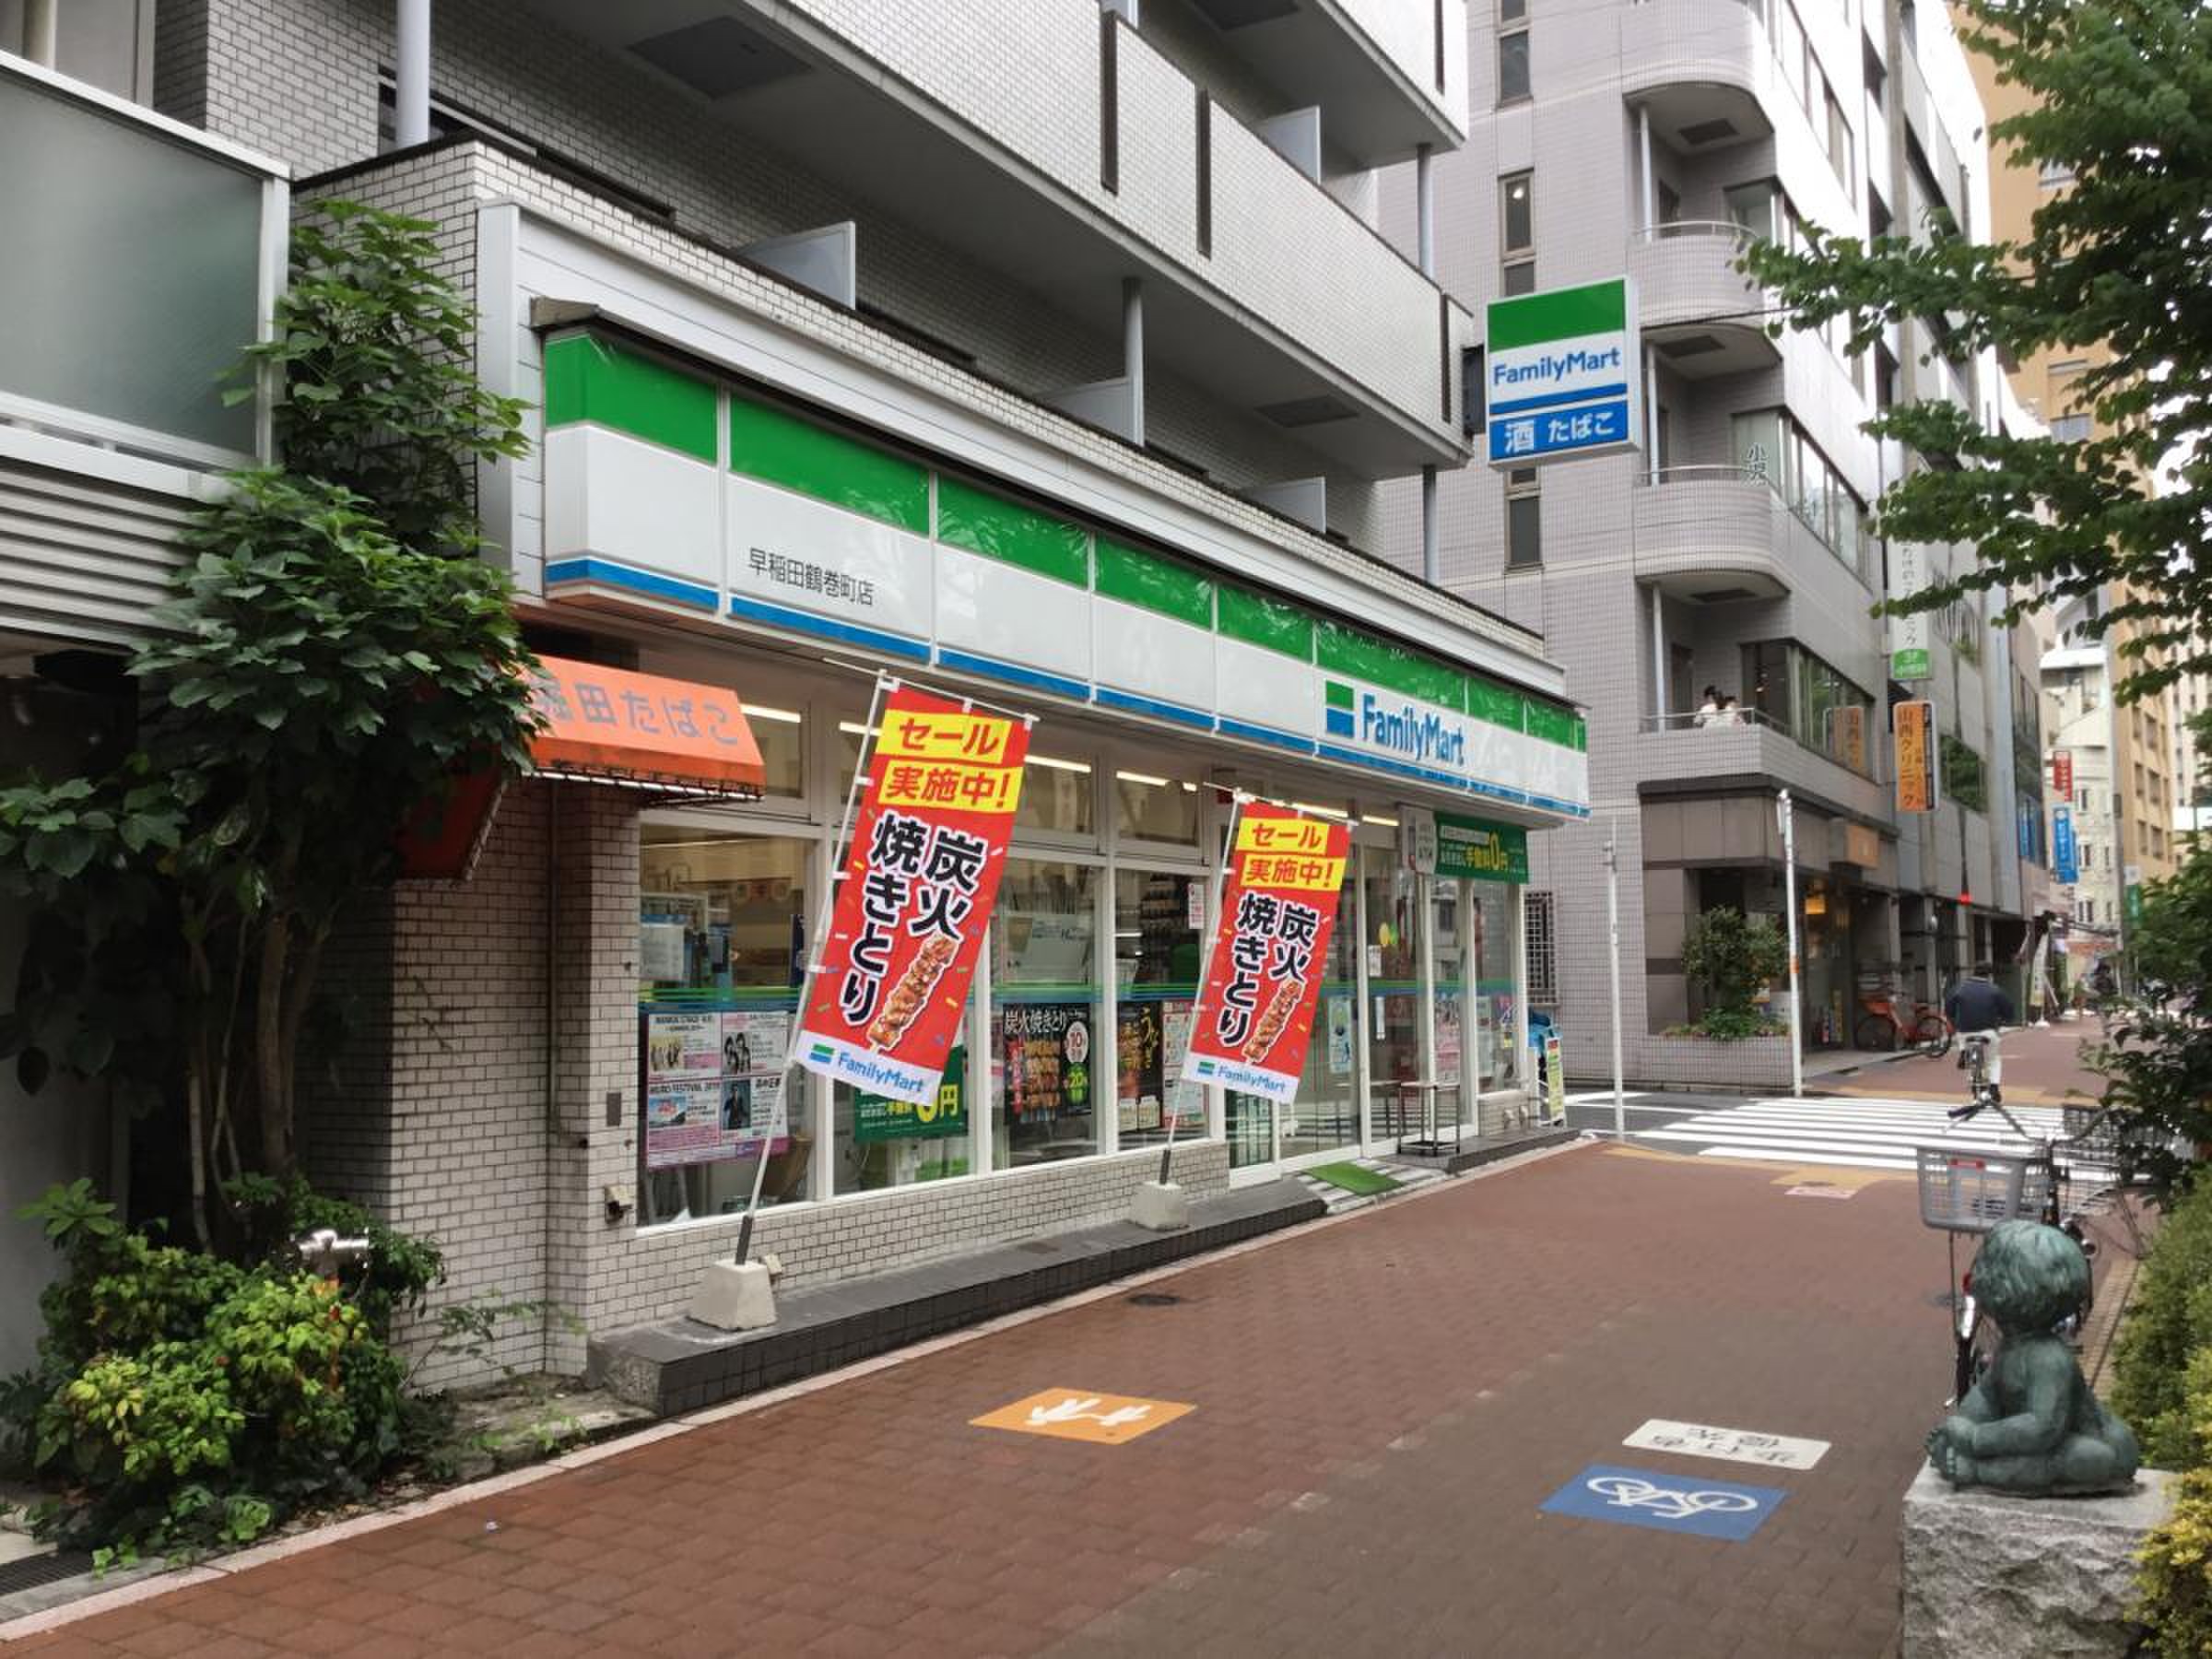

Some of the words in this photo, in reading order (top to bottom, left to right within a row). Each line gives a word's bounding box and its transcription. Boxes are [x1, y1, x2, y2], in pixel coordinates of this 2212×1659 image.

[1493, 347, 1621, 386] FamilyMart
[1503, 419, 1535, 453] 酒
[1547, 411, 1616, 443] たばこ
[748, 547, 874, 606] 早稲田鶴巻町店
[899, 717, 999, 756] セール
[1361, 692, 1465, 767] FamilyMart
[885, 765, 1011, 808] 実施中!
[1252, 822, 1323, 849] セール
[910, 830, 986, 940] 炭火
[1246, 858, 1335, 888] 実施中!
[842, 812, 926, 1022] 焼きとり
[1269, 904, 1318, 982] 炭火
[1218, 893, 1277, 1044] 焼きとり
[837, 1052, 924, 1093] FamilyMart
[1216, 1065, 1287, 1093] FamilyMart
